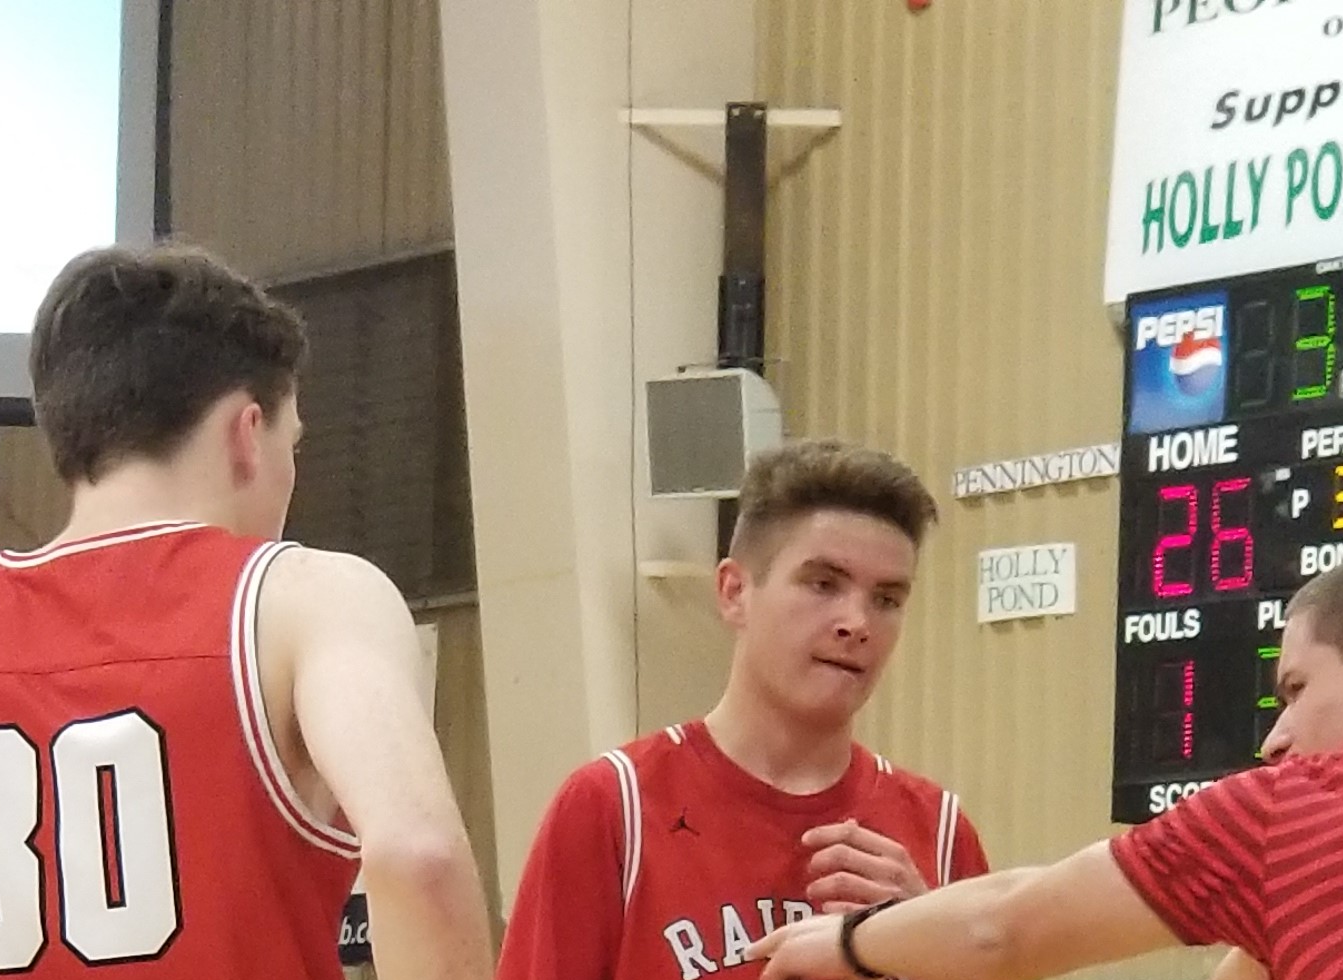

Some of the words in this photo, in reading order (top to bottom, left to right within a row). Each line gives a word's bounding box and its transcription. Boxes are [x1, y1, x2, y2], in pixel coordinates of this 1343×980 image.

[1142, 155, 1270, 254] HOLLY
[1136, 305, 1225, 350] PEPSI
[954, 446, 1119, 496] PENNINGTON
[1148, 424, 1240, 472] HOME
[1152, 477, 1254, 598] 26
[980, 548, 1067, 583] HOLLY
[988, 581, 1059, 613] POND
[1124, 608, 1201, 644] FOULS
